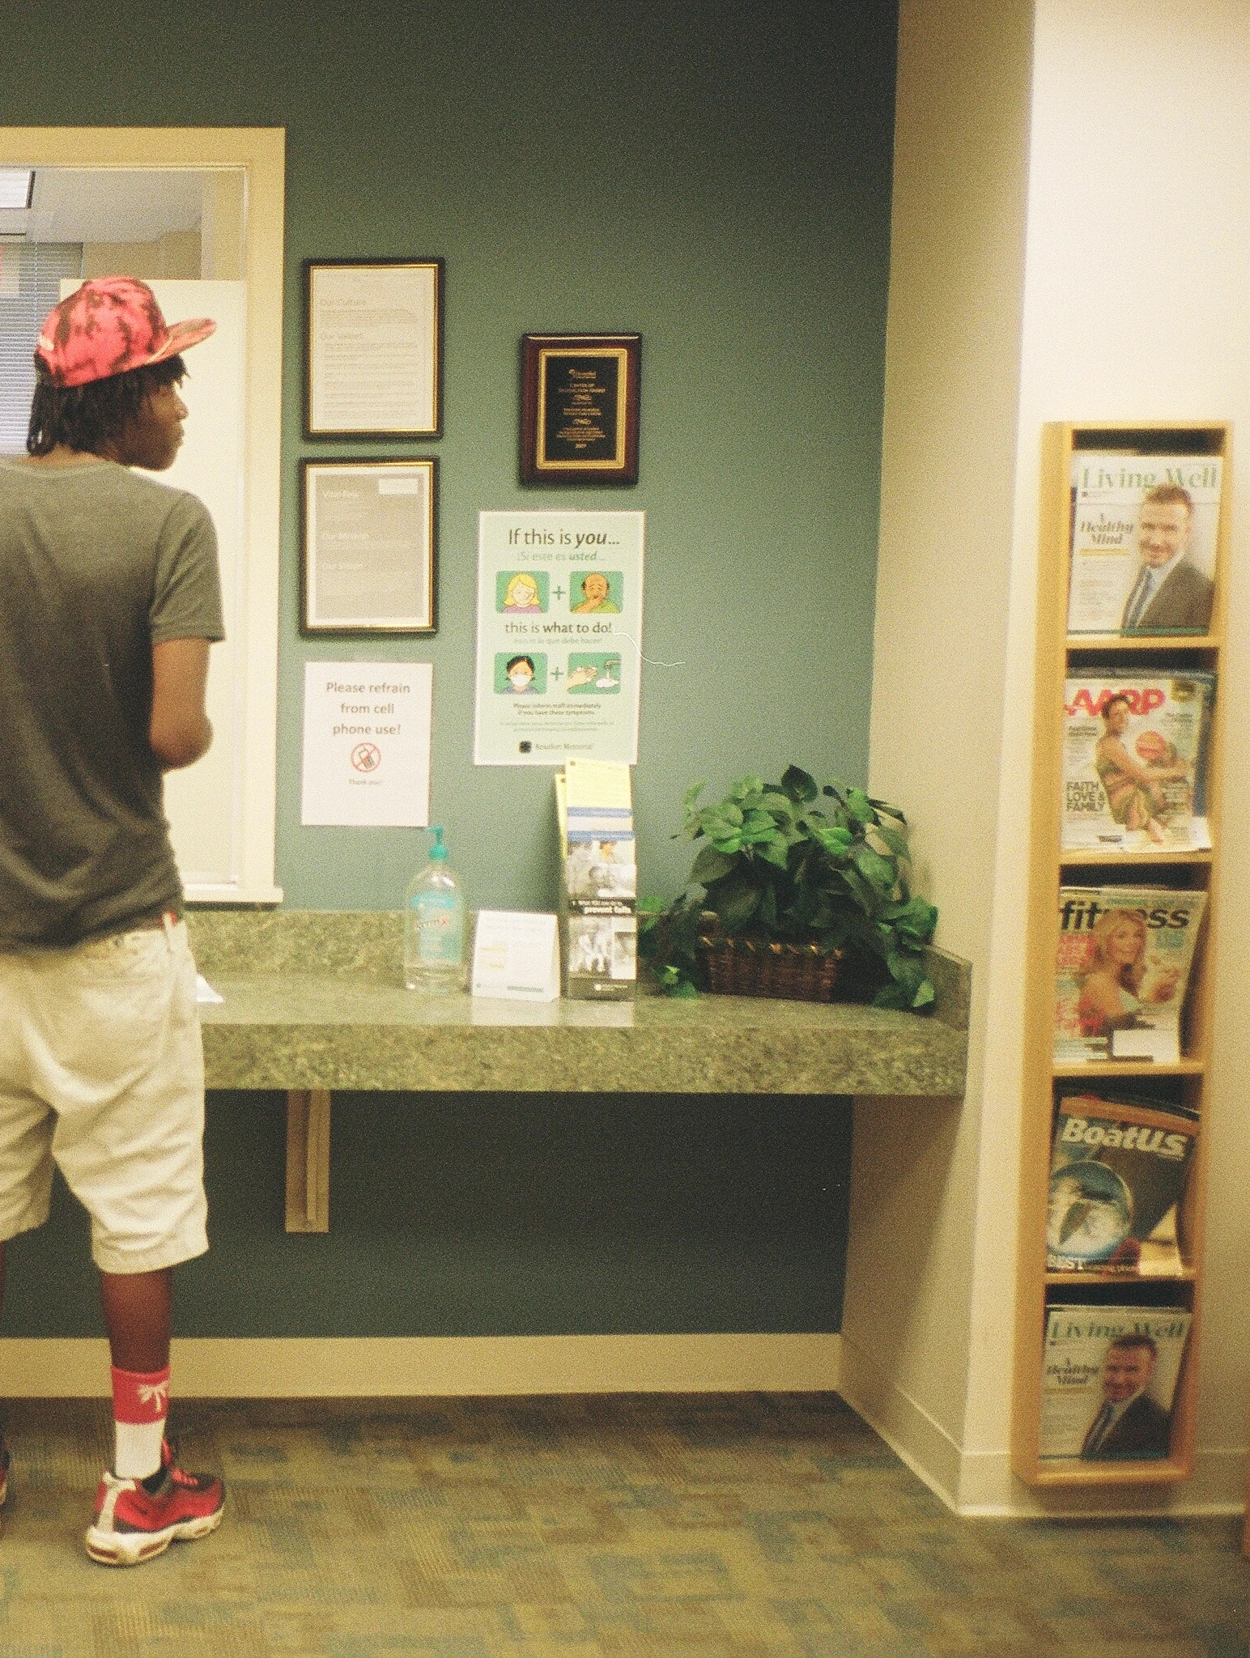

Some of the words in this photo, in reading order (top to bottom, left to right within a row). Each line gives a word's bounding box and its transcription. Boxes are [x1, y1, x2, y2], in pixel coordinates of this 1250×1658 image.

[508, 527, 522, 546] If
[524, 527, 555, 546] this
[559, 527, 571, 546] is
[505, 620, 528, 634] this
[531, 620, 540, 634] is
[542, 620, 573, 634] what
[576, 623, 589, 634] to
[592, 620, 612, 634] do!
[326, 682, 366, 693] Please
[369, 682, 411, 693] refrain
[340, 702, 370, 714] from
[373, 702, 395, 714] cell
[332, 723, 372, 737] phone
[375, 723, 402, 735] use!
[1066, 791, 1095, 801] LOVE
[1066, 801, 1106, 812] FAMILY
[1061, 1117, 1189, 1159] BoatUS
